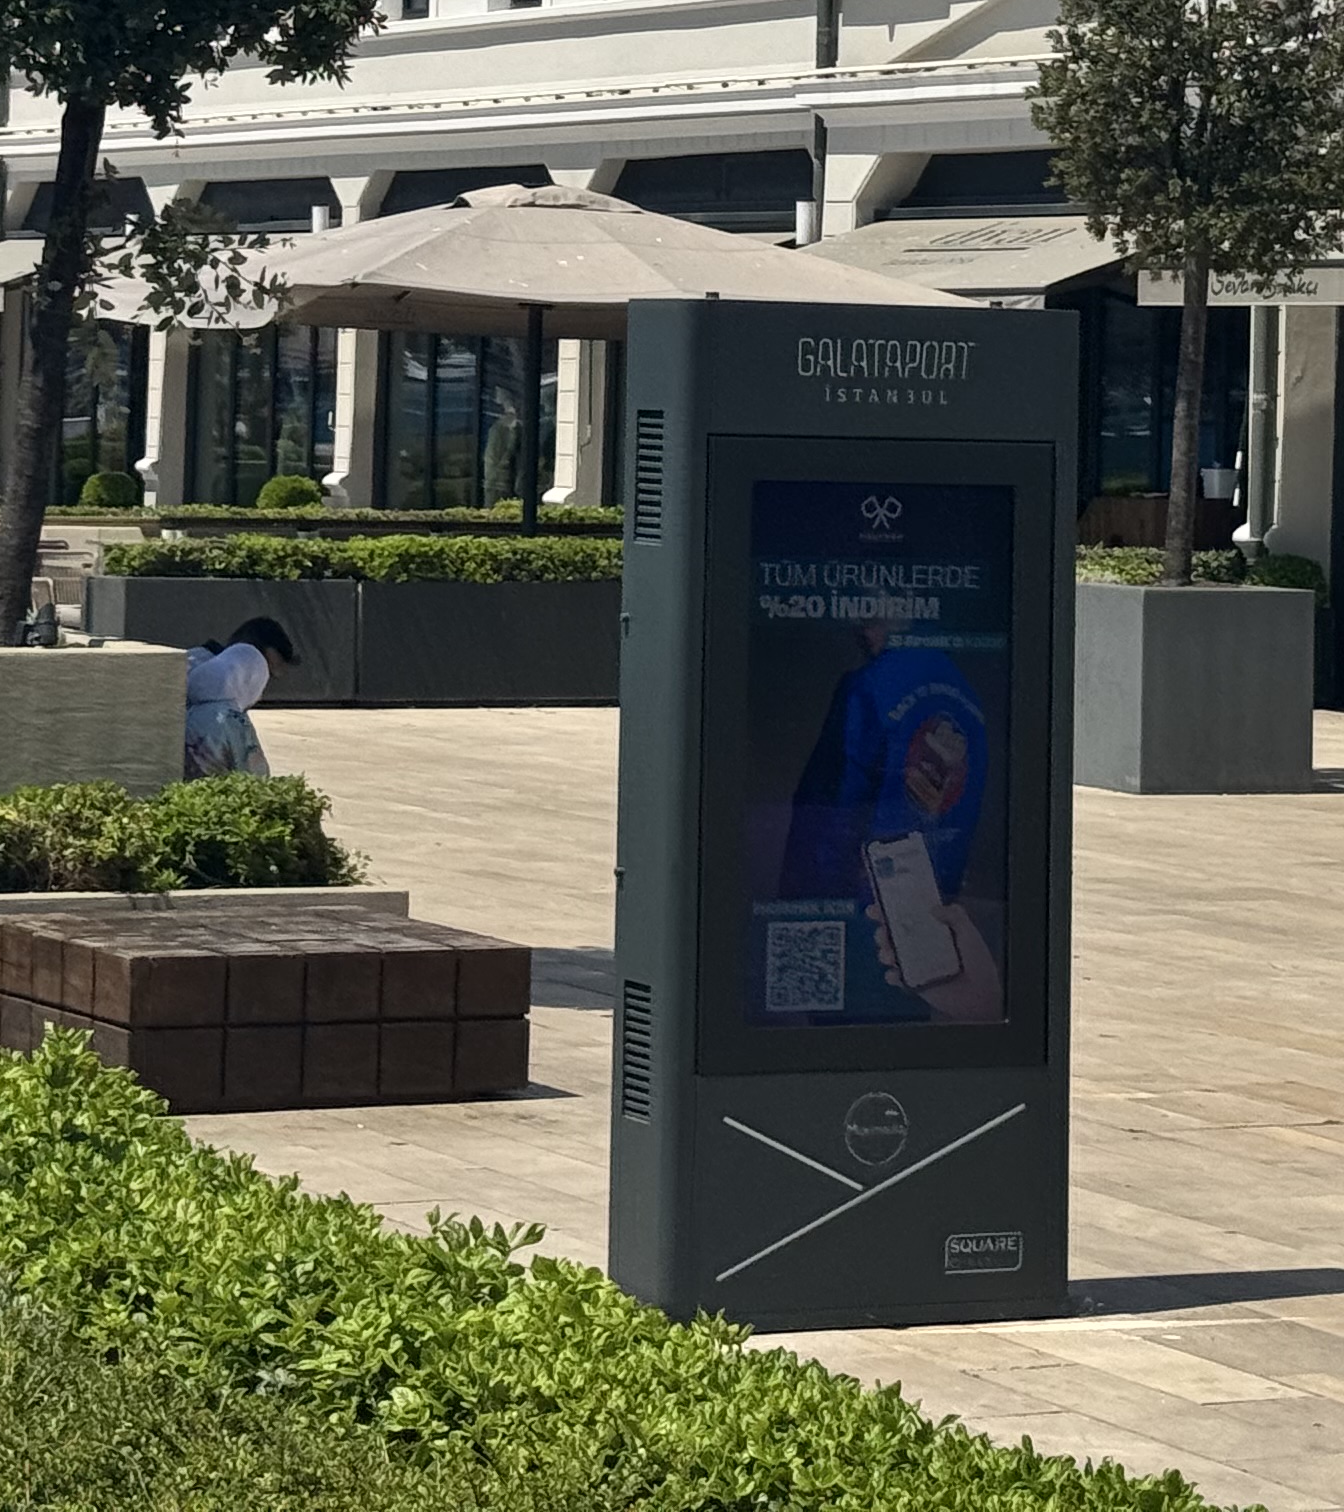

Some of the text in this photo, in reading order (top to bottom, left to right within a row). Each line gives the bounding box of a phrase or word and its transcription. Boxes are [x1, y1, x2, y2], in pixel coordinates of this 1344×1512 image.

[797, 337, 978, 380] GALATAPORT
[759, 560, 981, 590] TÜM ÜRÜNLERDE
[759, 595, 825, 619] %20
[950, 1236, 1018, 1253] SQUARE
